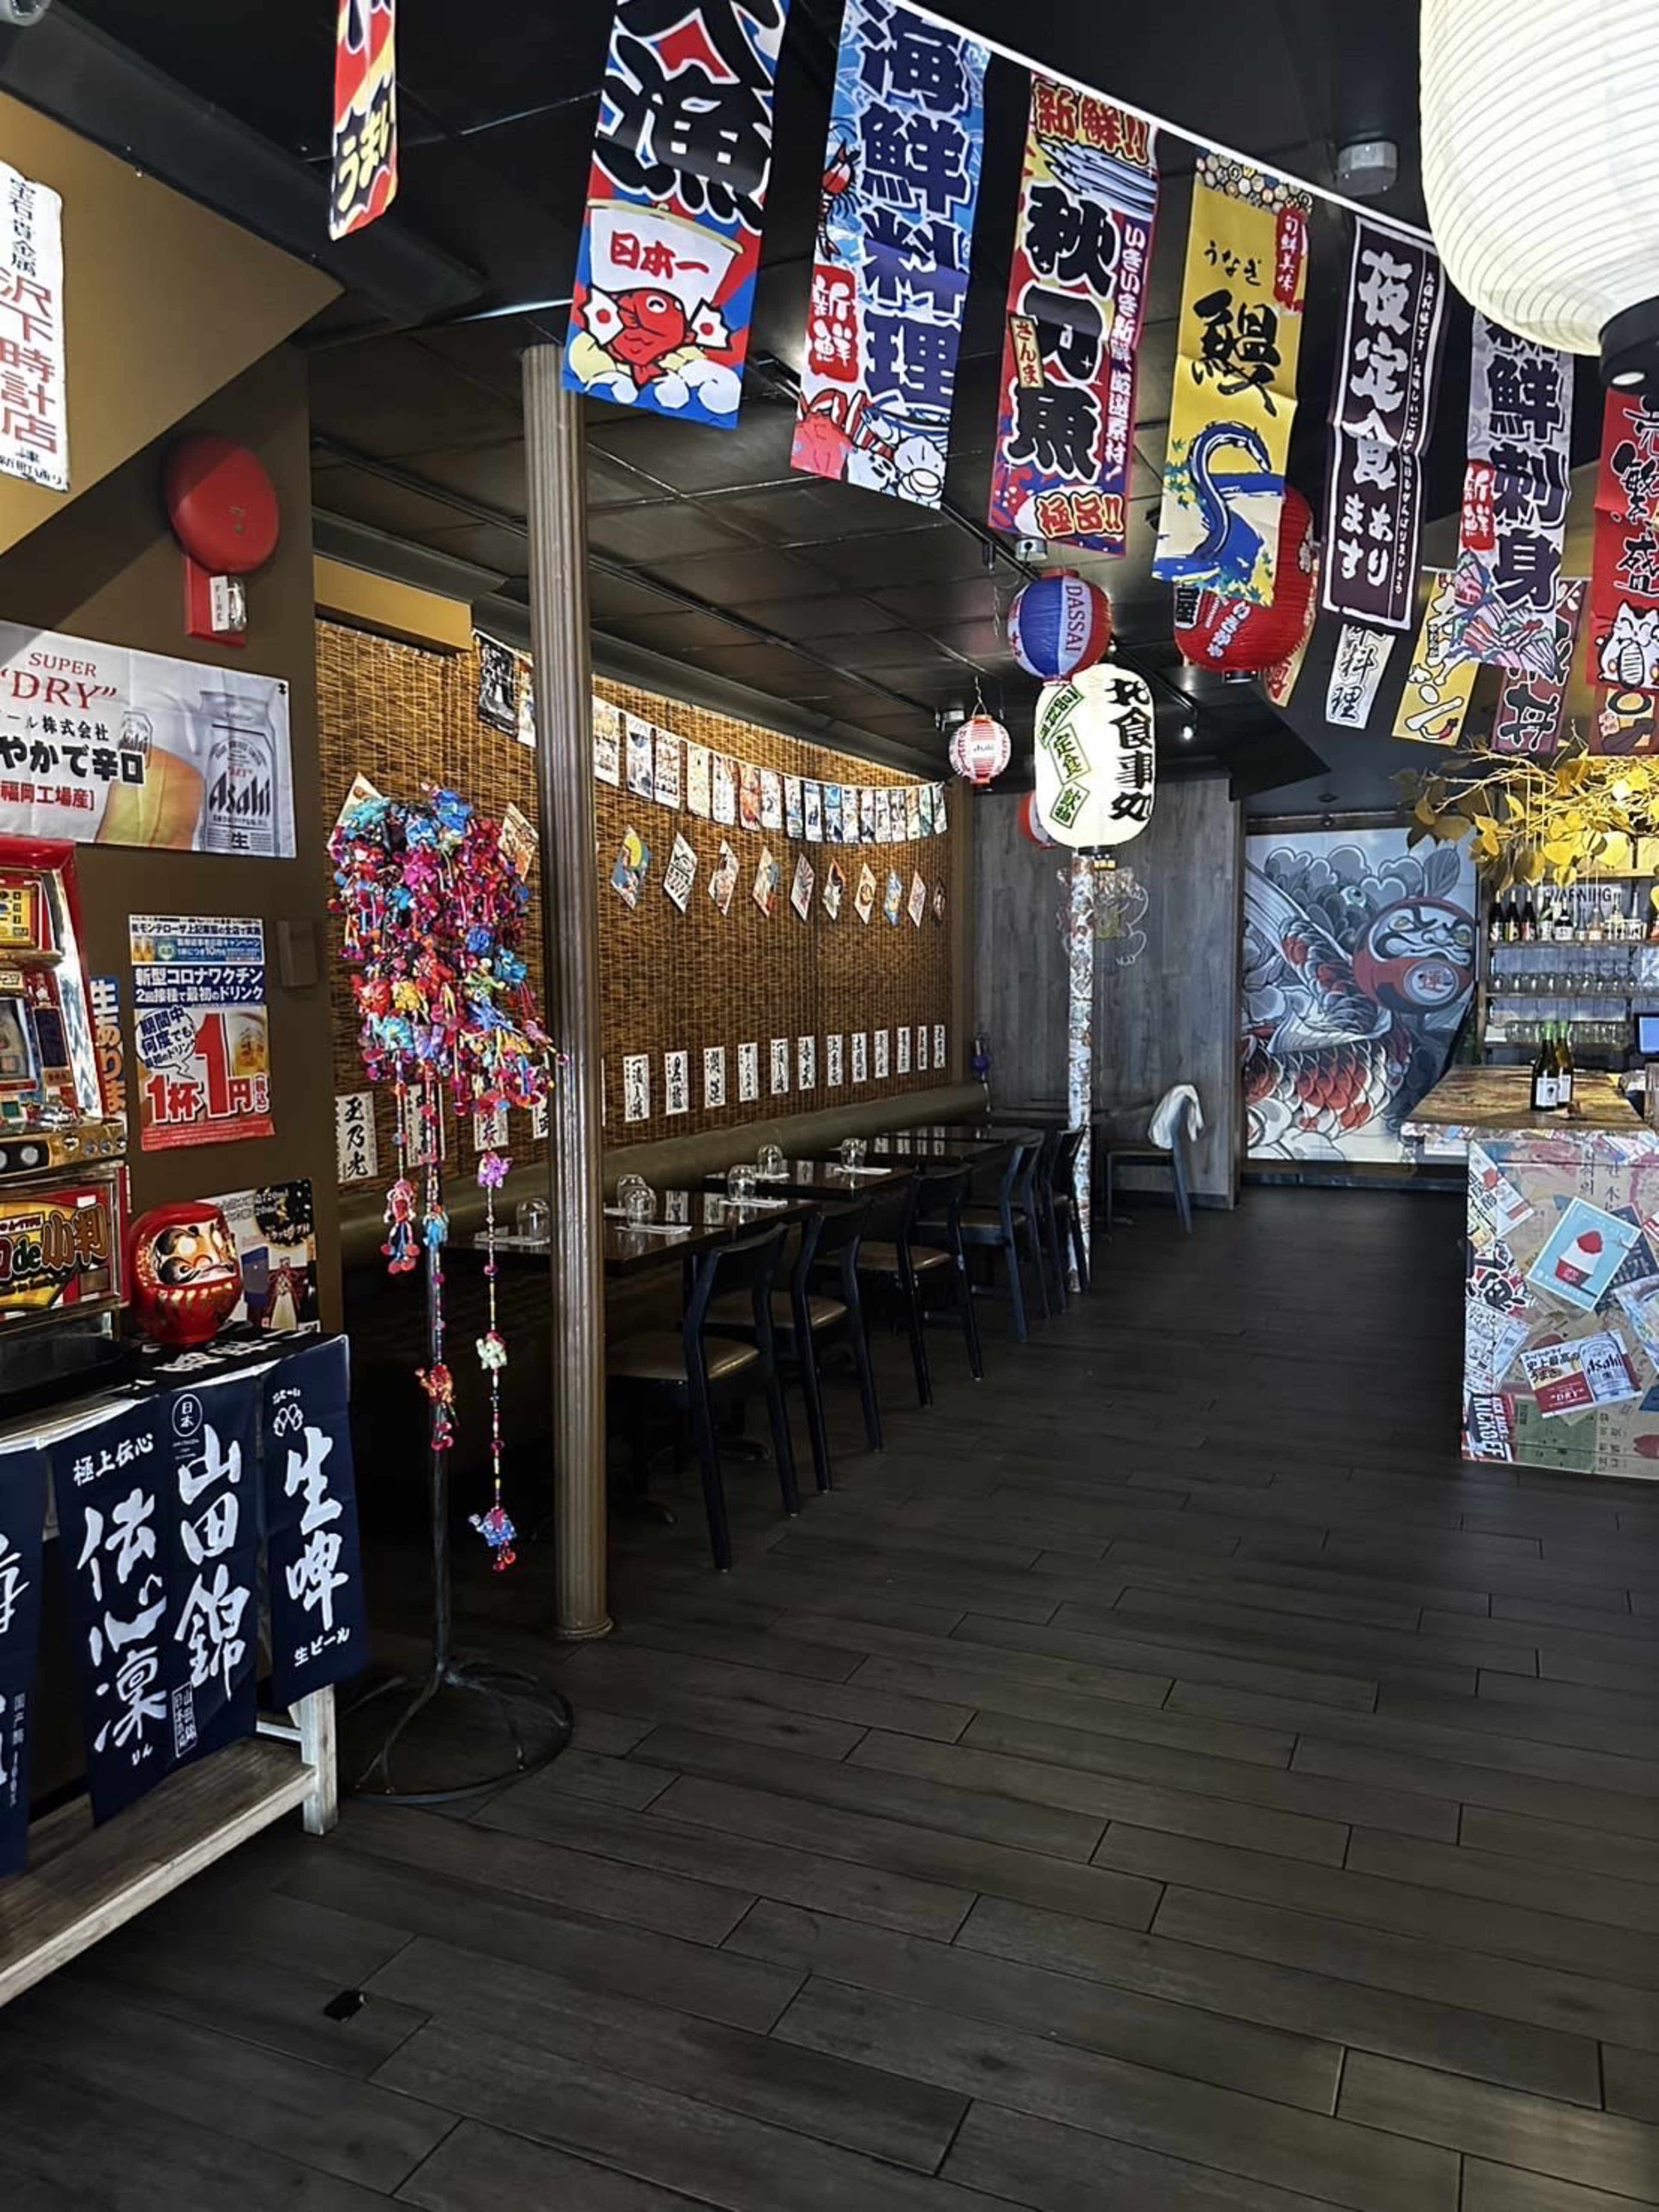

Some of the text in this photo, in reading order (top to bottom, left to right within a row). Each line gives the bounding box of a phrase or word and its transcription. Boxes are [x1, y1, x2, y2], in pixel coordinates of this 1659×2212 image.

[609, 230, 710, 278] 日本一
[1205, 240, 1262, 286] うなぎ
[1015, 321, 1040, 385] さんま
[1065, 585, 1087, 652] DASSAI
[29, 652, 97, 677] SUPER
[1053, 733, 1083, 780] 定食
[1105, 677, 1153, 822] お食事処
[209, 771, 271, 816] Asahi
[230, 831, 250, 851] 生
[135, 967, 263, 987] 新型コロナワクチン
[142, 1027, 192, 1056] 何度でも
[1588, 1353, 1622, 1375] Asahi
[180, 1401, 194, 1428] 日本
[73, 1433, 154, 1486] 極上伝心
[174, 1424, 250, 1701] 山田錦
[294, 1626, 350, 1667] 生ビール
